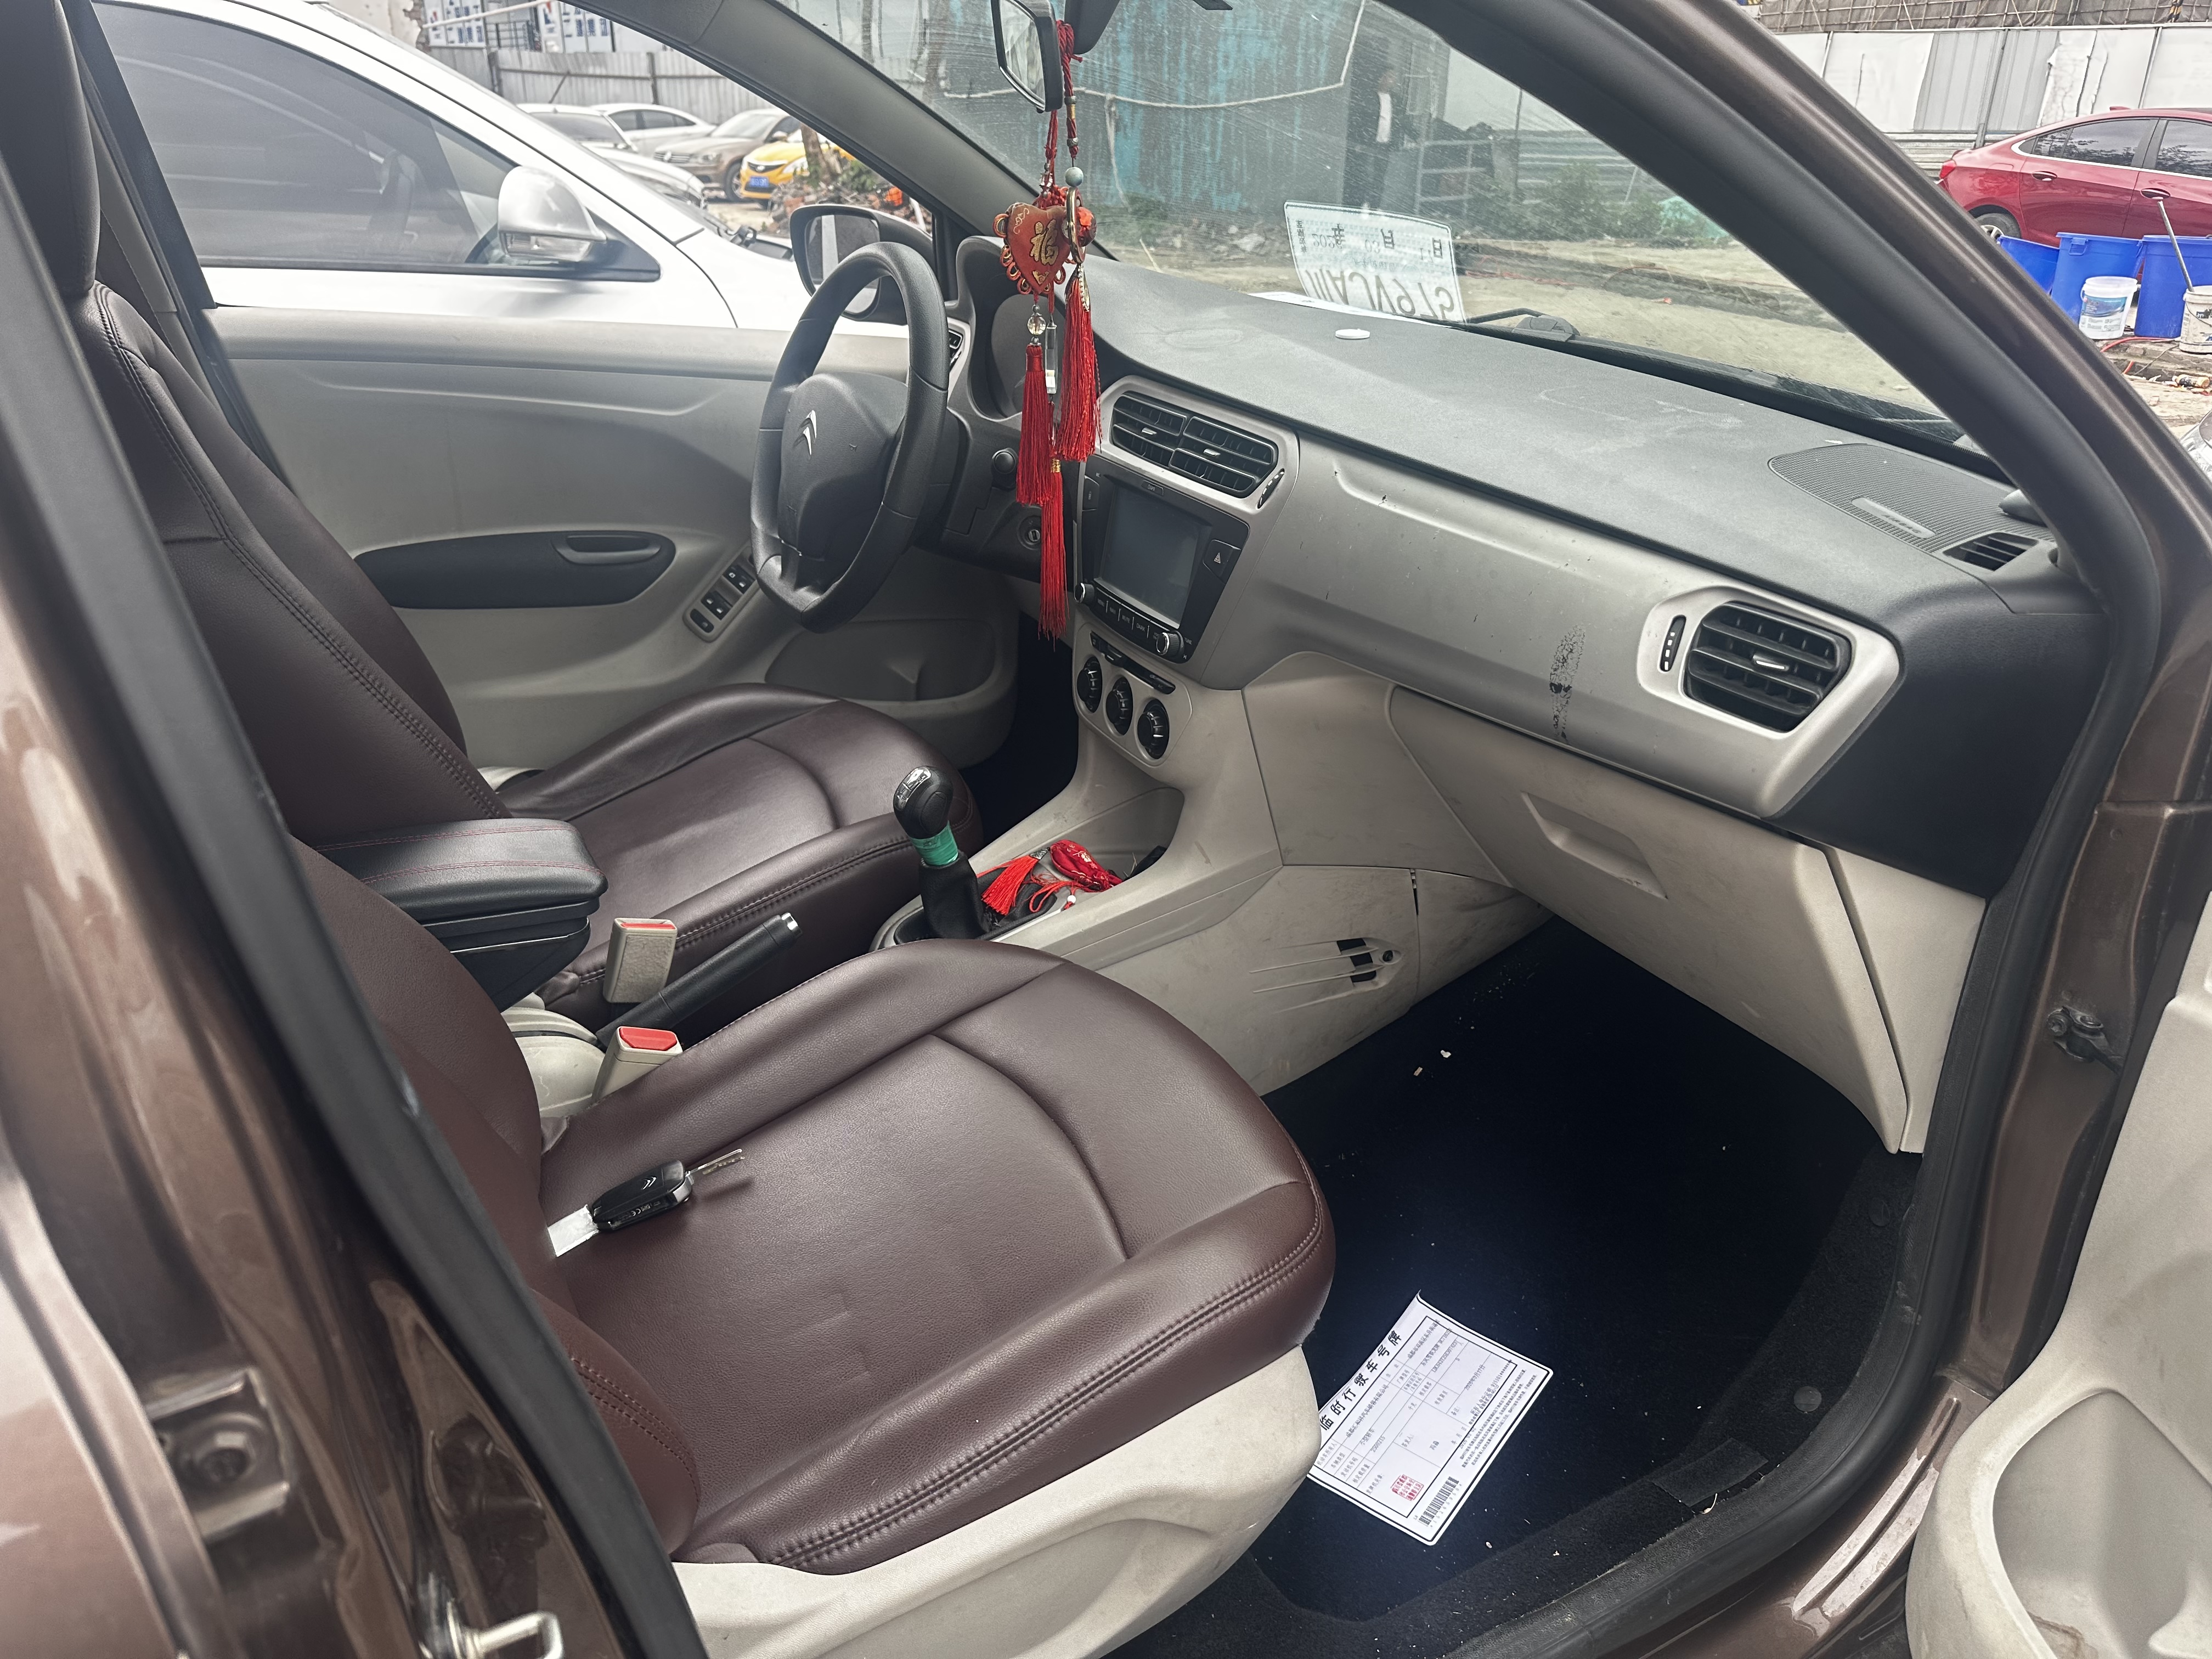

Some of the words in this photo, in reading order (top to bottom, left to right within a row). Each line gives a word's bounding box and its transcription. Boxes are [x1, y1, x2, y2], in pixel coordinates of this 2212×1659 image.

[1030, 219, 1059, 266] 福
[1136, 623, 1146, 632] DARK
[1317, 1329, 1403, 1431] 临时行驶车号牌
